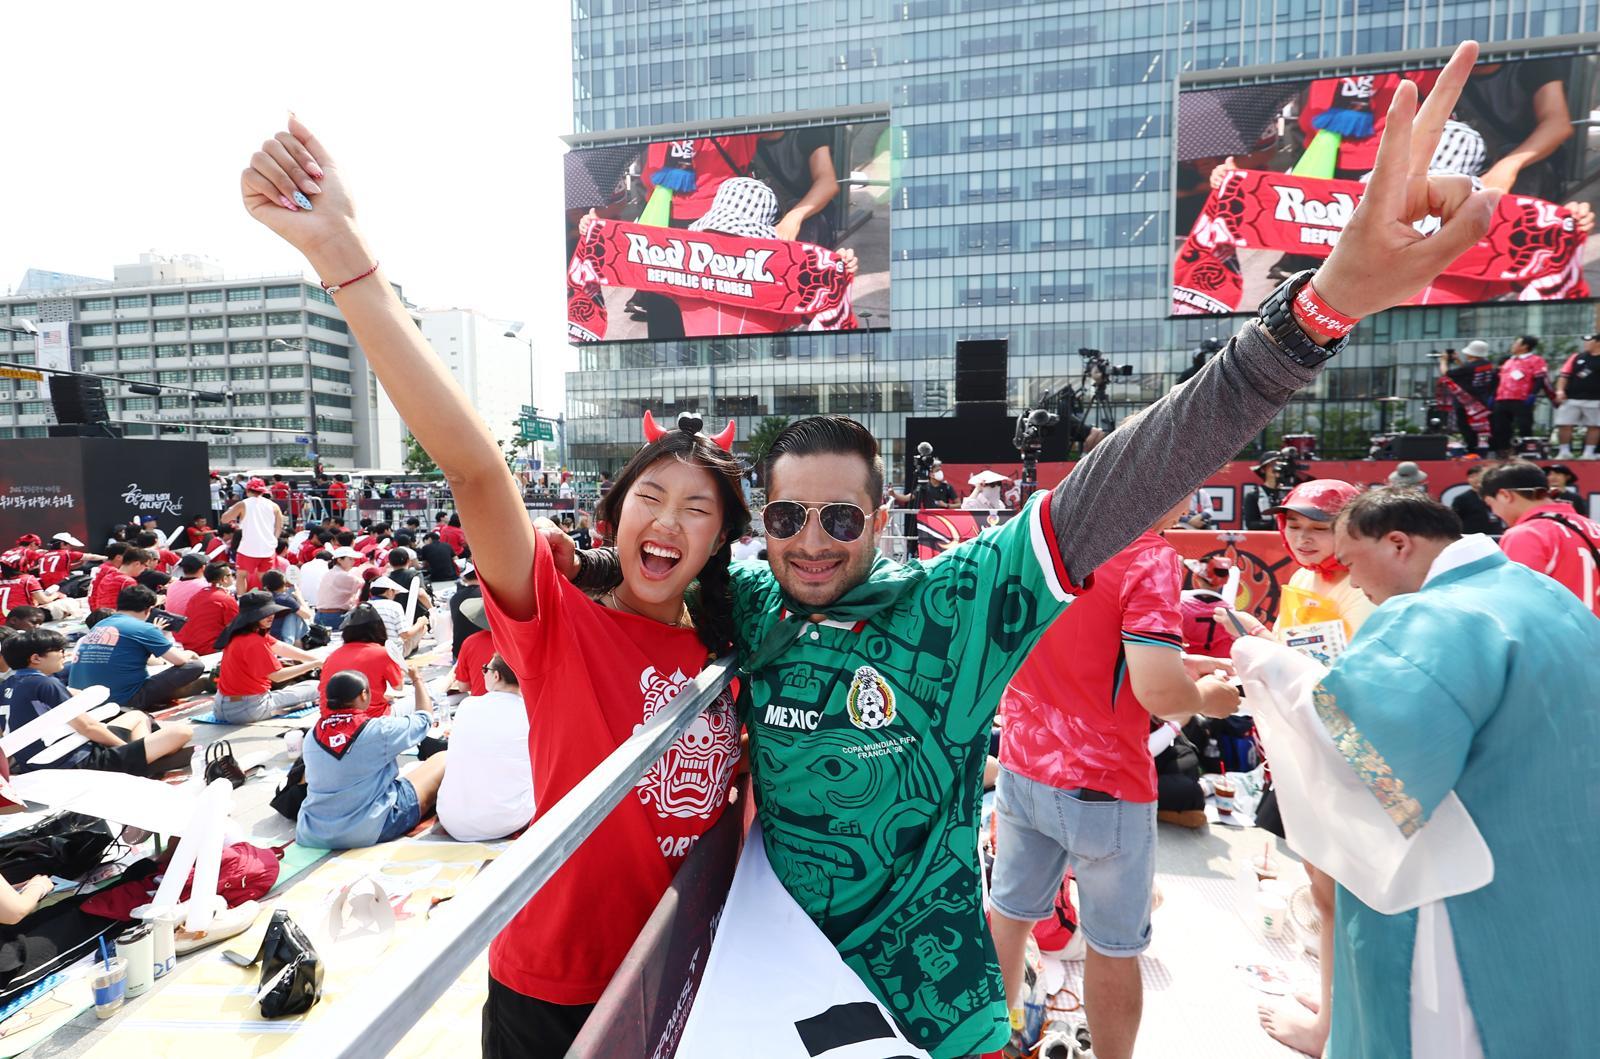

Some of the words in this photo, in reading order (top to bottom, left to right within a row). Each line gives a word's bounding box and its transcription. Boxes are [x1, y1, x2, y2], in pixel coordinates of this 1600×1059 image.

[1272, 185, 1355, 228] Red
[1300, 227, 1340, 247] REPU
[624, 232, 685, 270] Red
[646, 268, 700, 289] REPUBLIC
[701, 277, 716, 291] OF
[716, 280, 754, 298] KOREA
[40, 555, 60, 574] 17
[1195, 617, 1217, 651] 7
[764, 704, 825, 730] MEXIC
[842, 745, 863, 754] COPA
[863, 738, 899, 751] MUNDIAL
[900, 736, 917, 745] FIFA
[857, 748, 892, 759] FRANCIA
[656, 834, 700, 857] OR
